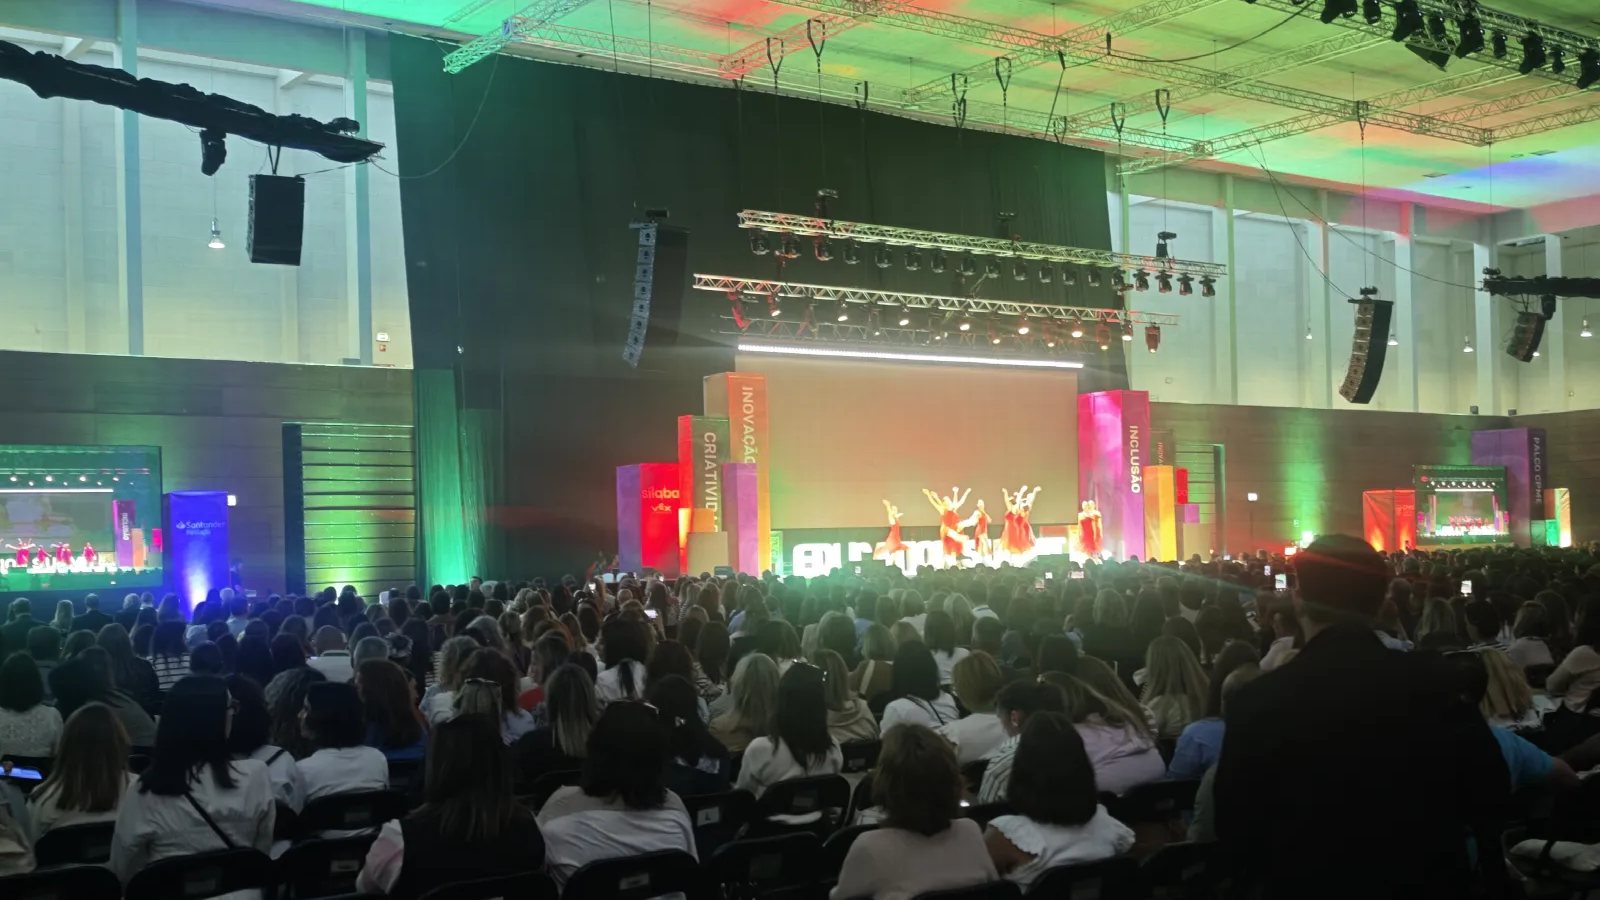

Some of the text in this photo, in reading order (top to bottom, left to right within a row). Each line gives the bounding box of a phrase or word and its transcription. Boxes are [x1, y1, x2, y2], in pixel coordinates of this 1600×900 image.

[1129, 425, 1143, 493] INCLUSÃO
[1533, 437, 1541, 472] PALCO
[704, 432, 719, 532] CRIATIVID
[186, 520, 226, 529] Santander
